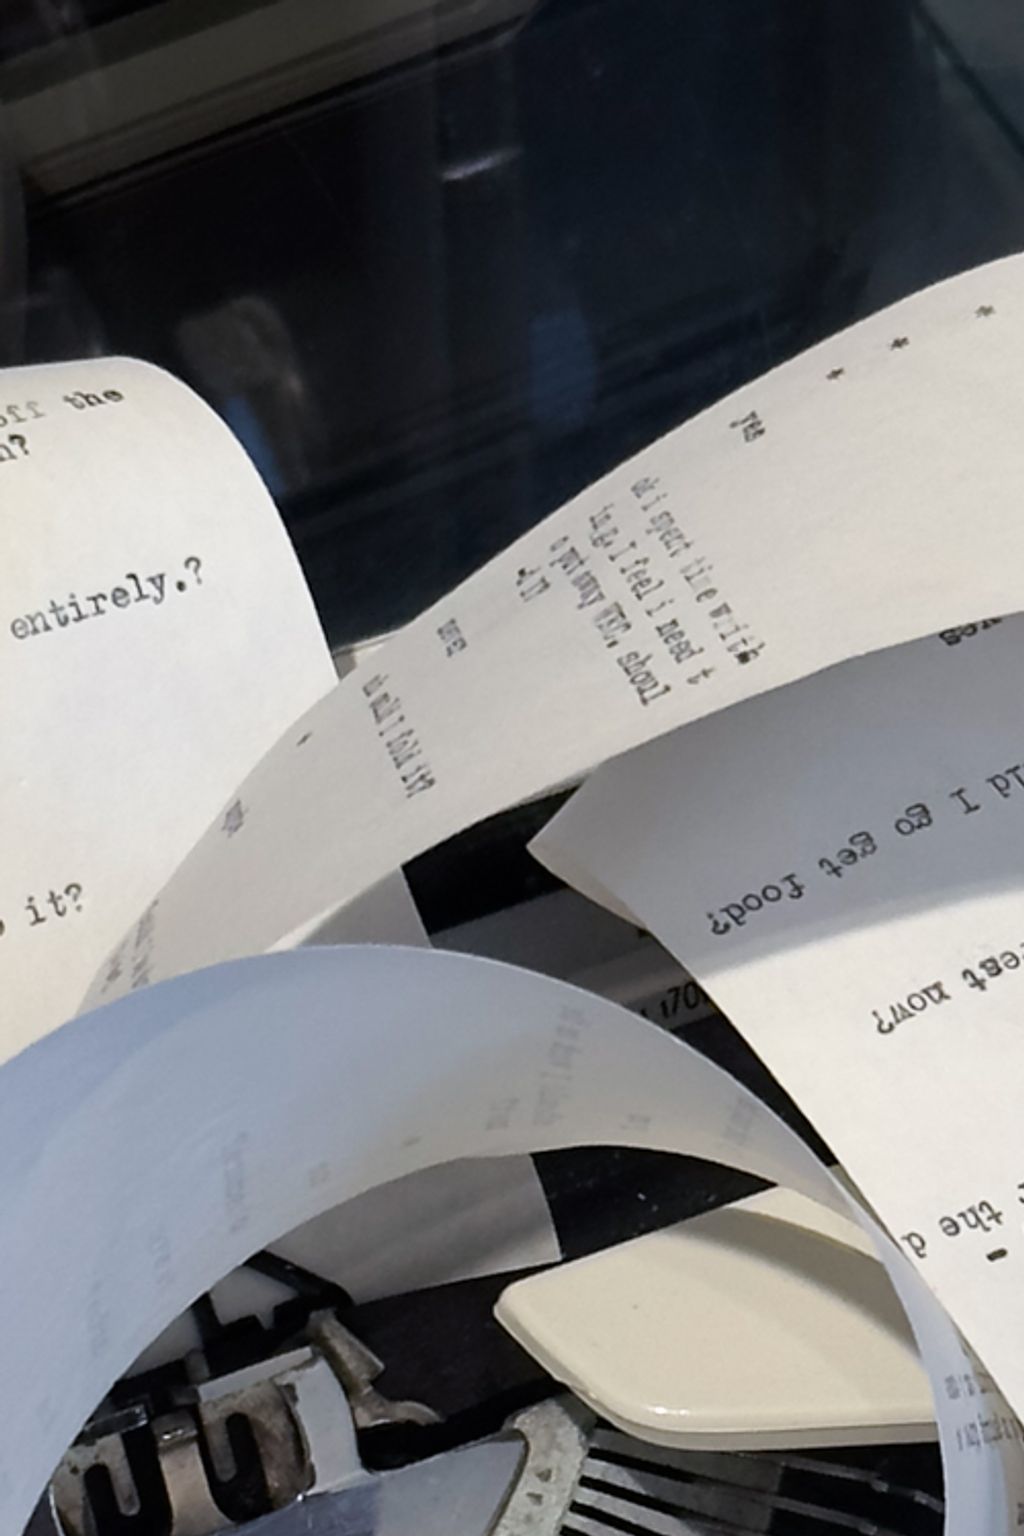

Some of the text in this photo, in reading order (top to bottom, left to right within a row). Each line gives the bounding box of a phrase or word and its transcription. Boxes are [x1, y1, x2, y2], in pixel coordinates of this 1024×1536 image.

[62, 390, 124, 410] the
[11, 557, 204, 640] entirely.?
[618, 556, 665, 603] feel
[653, 617, 706, 665] need
[615, 650, 673, 708] shoul
[893, 802, 934, 837] go
[948, 786, 982, 816] I
[817, 830, 879, 879] get
[24, 882, 82, 927] it?
[706, 872, 806, 936] food?
[870, 979, 953, 1036] now?
[937, 1199, 1004, 1238] the
[899, 1230, 928, 1260] d
